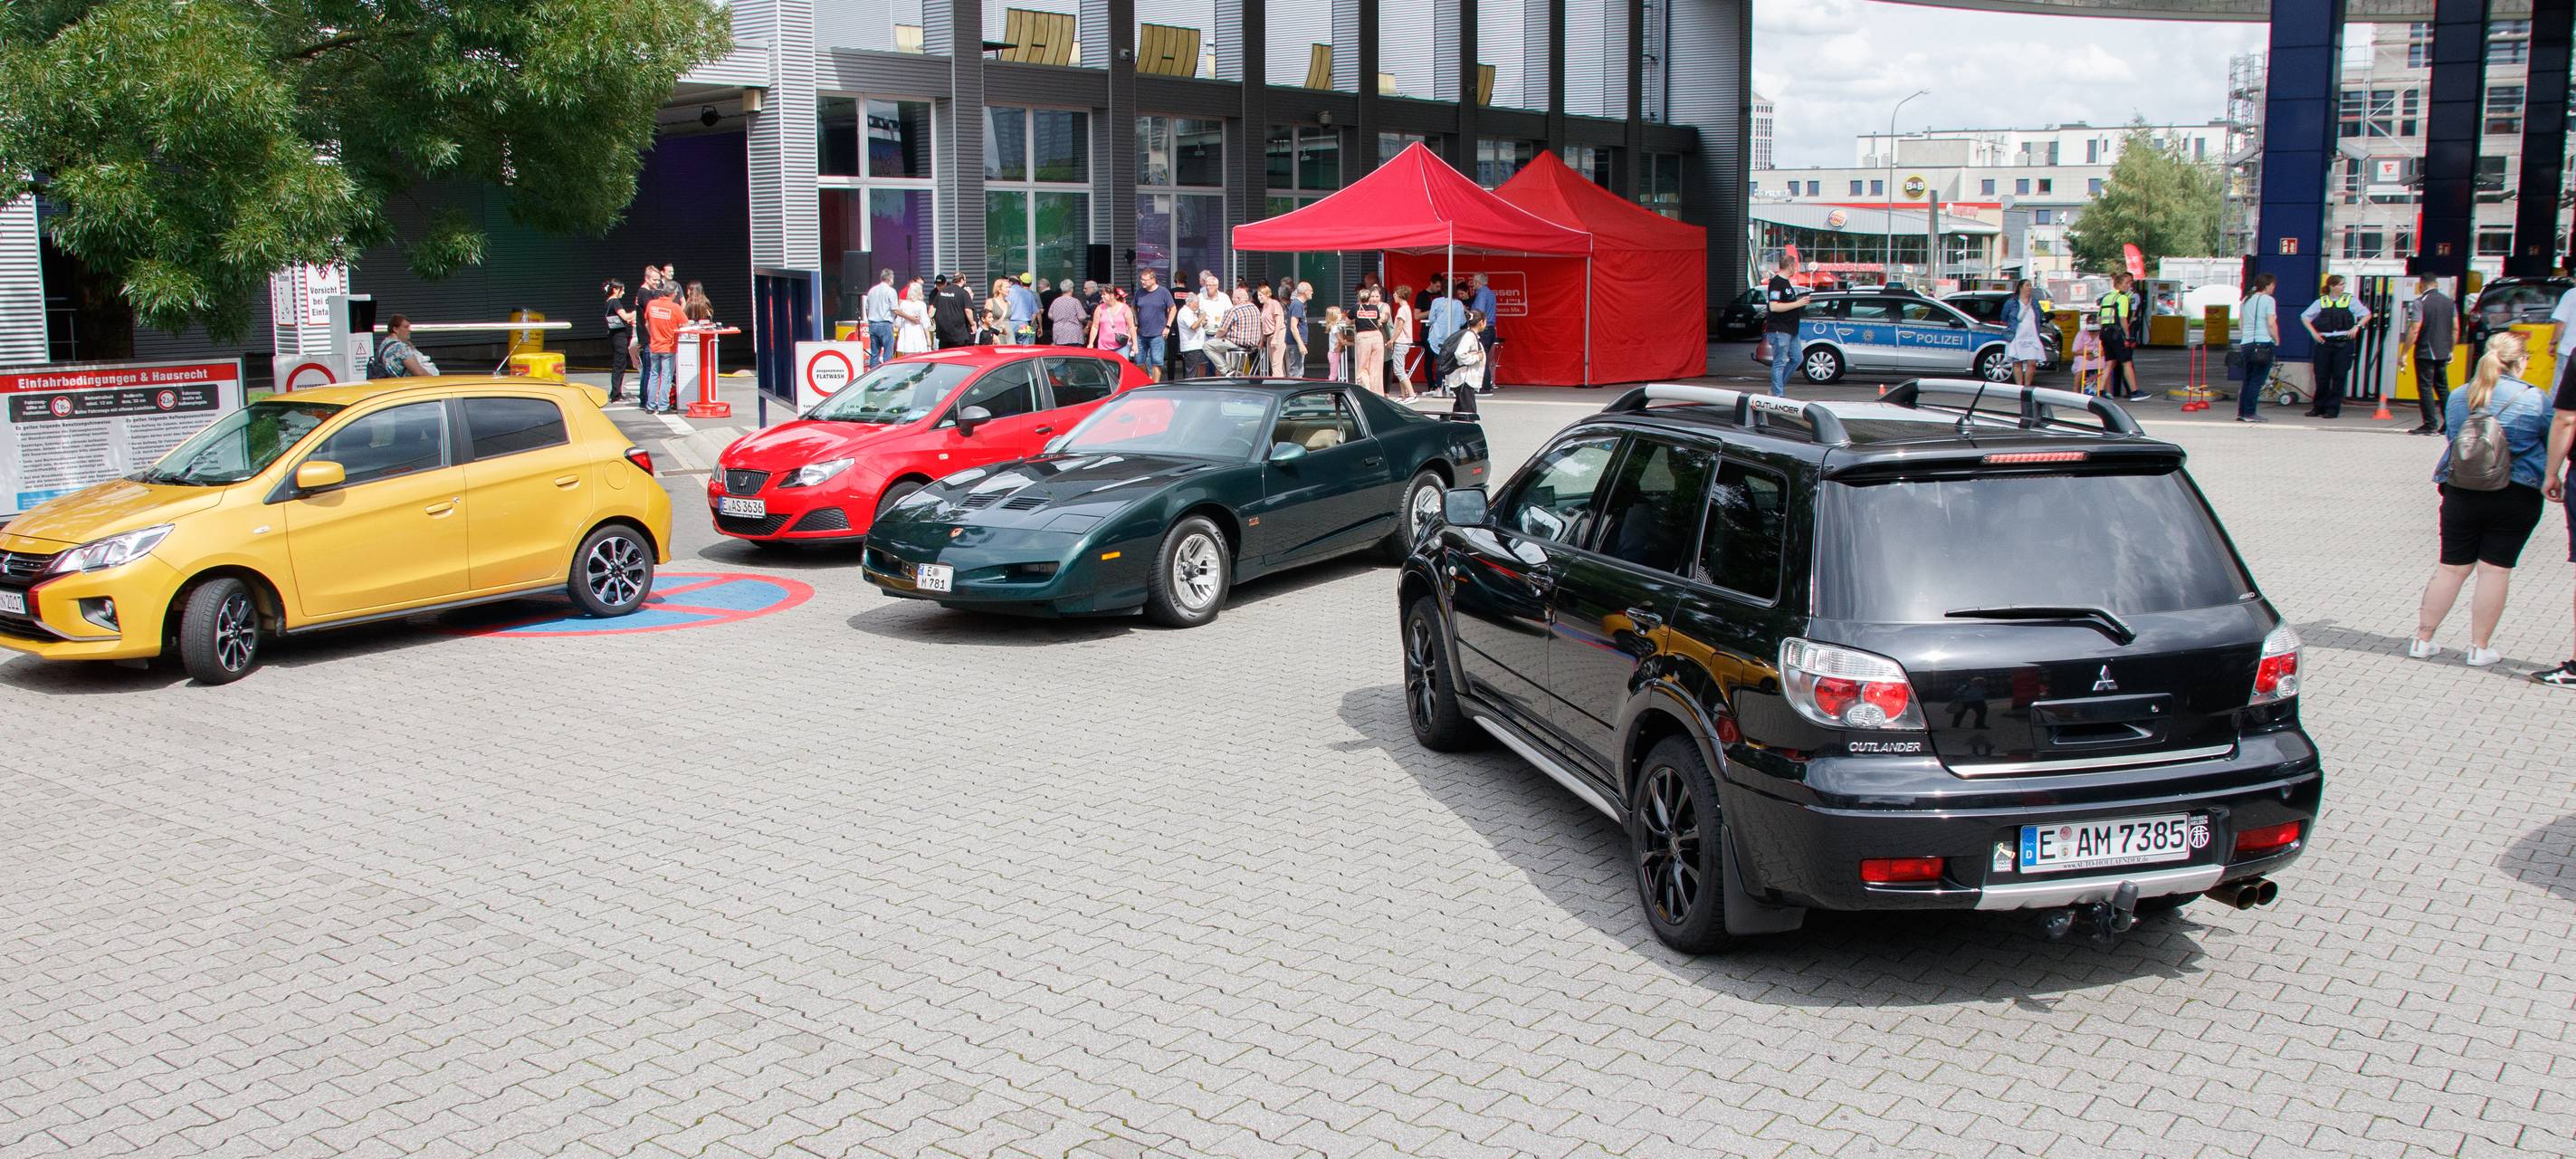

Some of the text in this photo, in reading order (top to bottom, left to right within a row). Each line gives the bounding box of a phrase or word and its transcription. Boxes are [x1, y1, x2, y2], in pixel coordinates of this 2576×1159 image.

[1906, 182, 1924, 190] B&B
[1916, 333, 1963, 346] POLIZEI
[18, 369, 208, 389] Einfahrbedingungen & Hausrecht
[1756, 400, 1798, 414] OUTLANDER
[731, 500, 741, 512] AS
[742, 501, 763, 514] 3636
[927, 566, 932, 577] E
[930, 578, 946, 590] 781
[1848, 741, 1922, 753] OUTLANDER
[2038, 819, 2186, 860] E AM 7385
[2025, 848, 2034, 859] D
